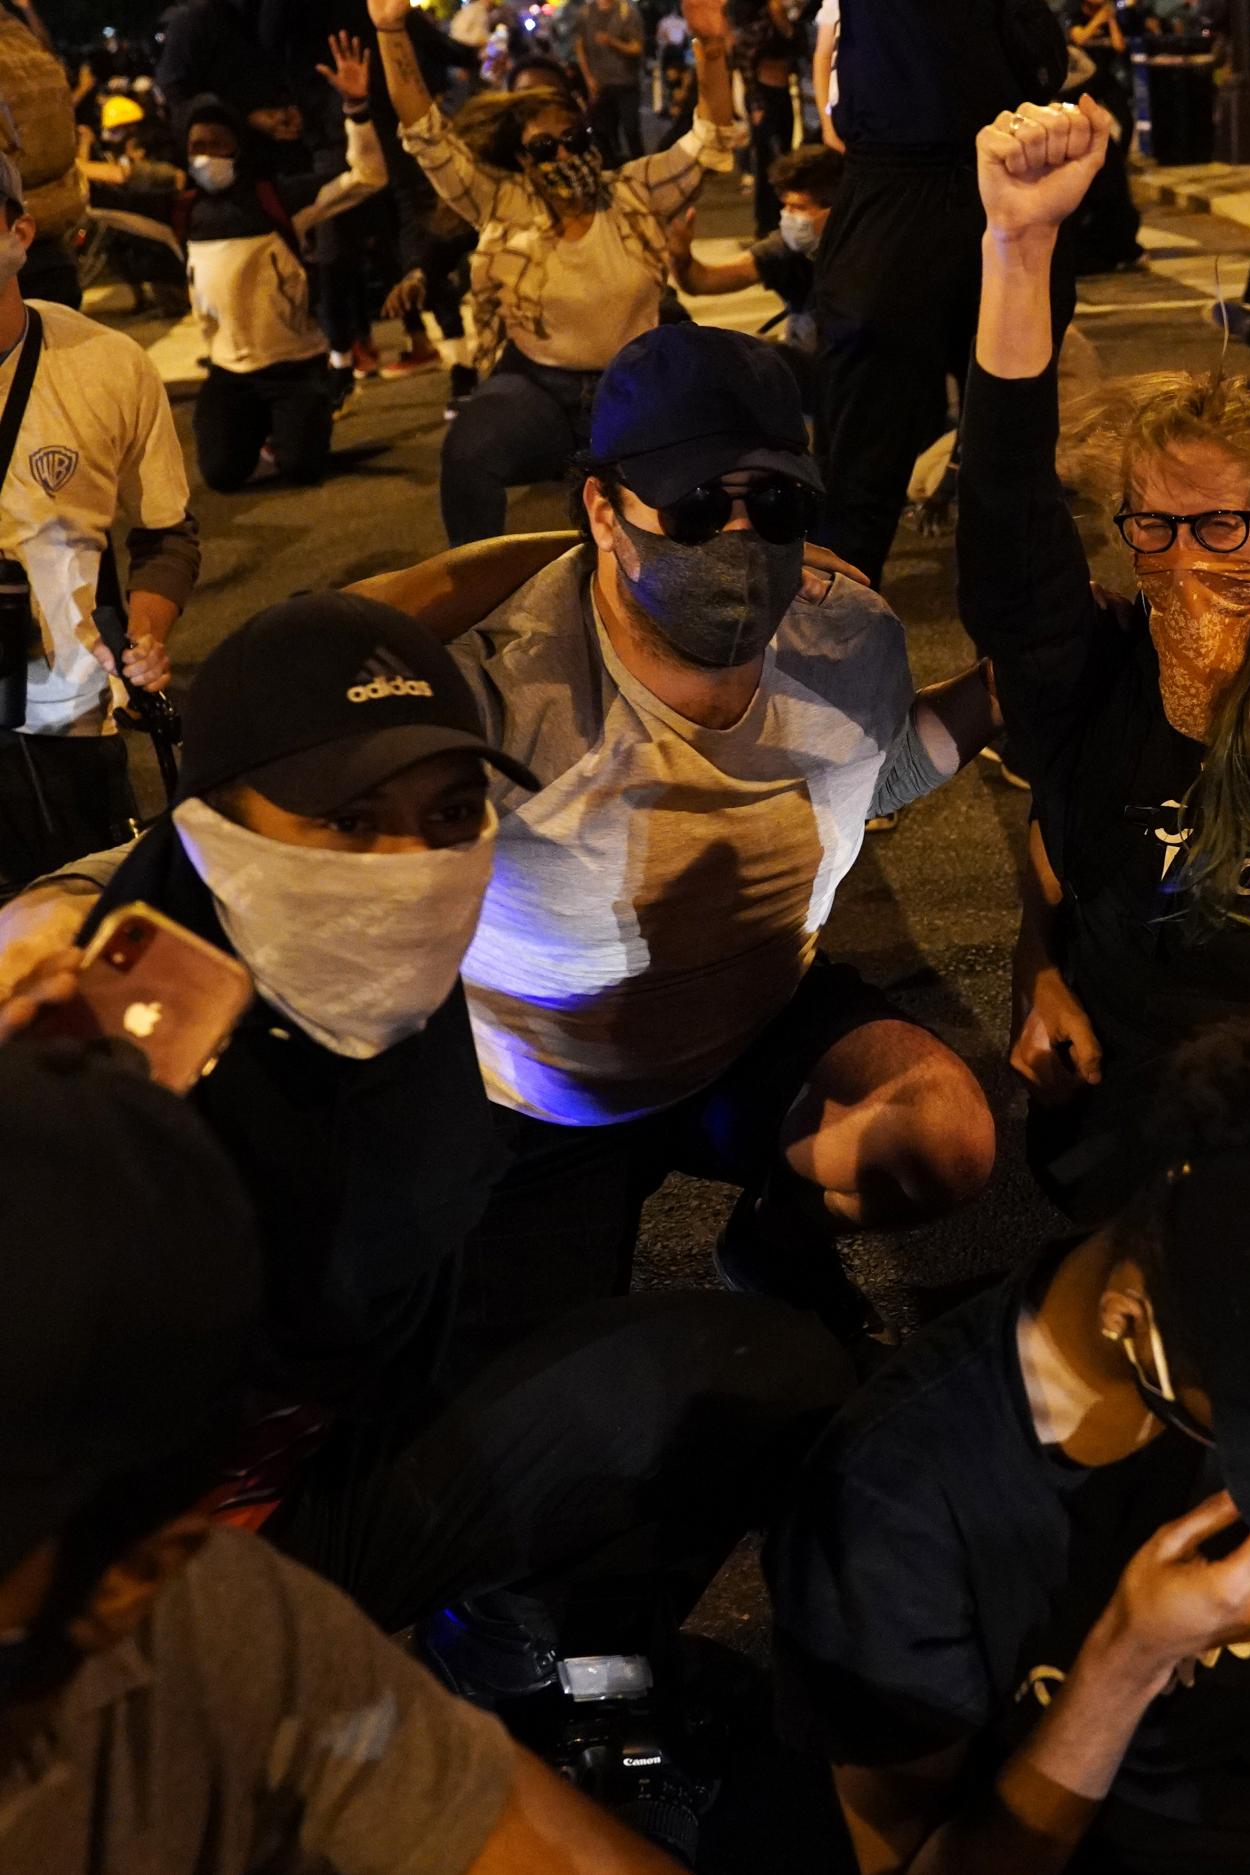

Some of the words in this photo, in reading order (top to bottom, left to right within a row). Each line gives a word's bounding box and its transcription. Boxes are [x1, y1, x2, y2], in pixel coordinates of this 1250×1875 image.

[33, 449, 75, 492] WB
[346, 676, 433, 702] adidas
[623, 1756, 661, 1767] Canon
